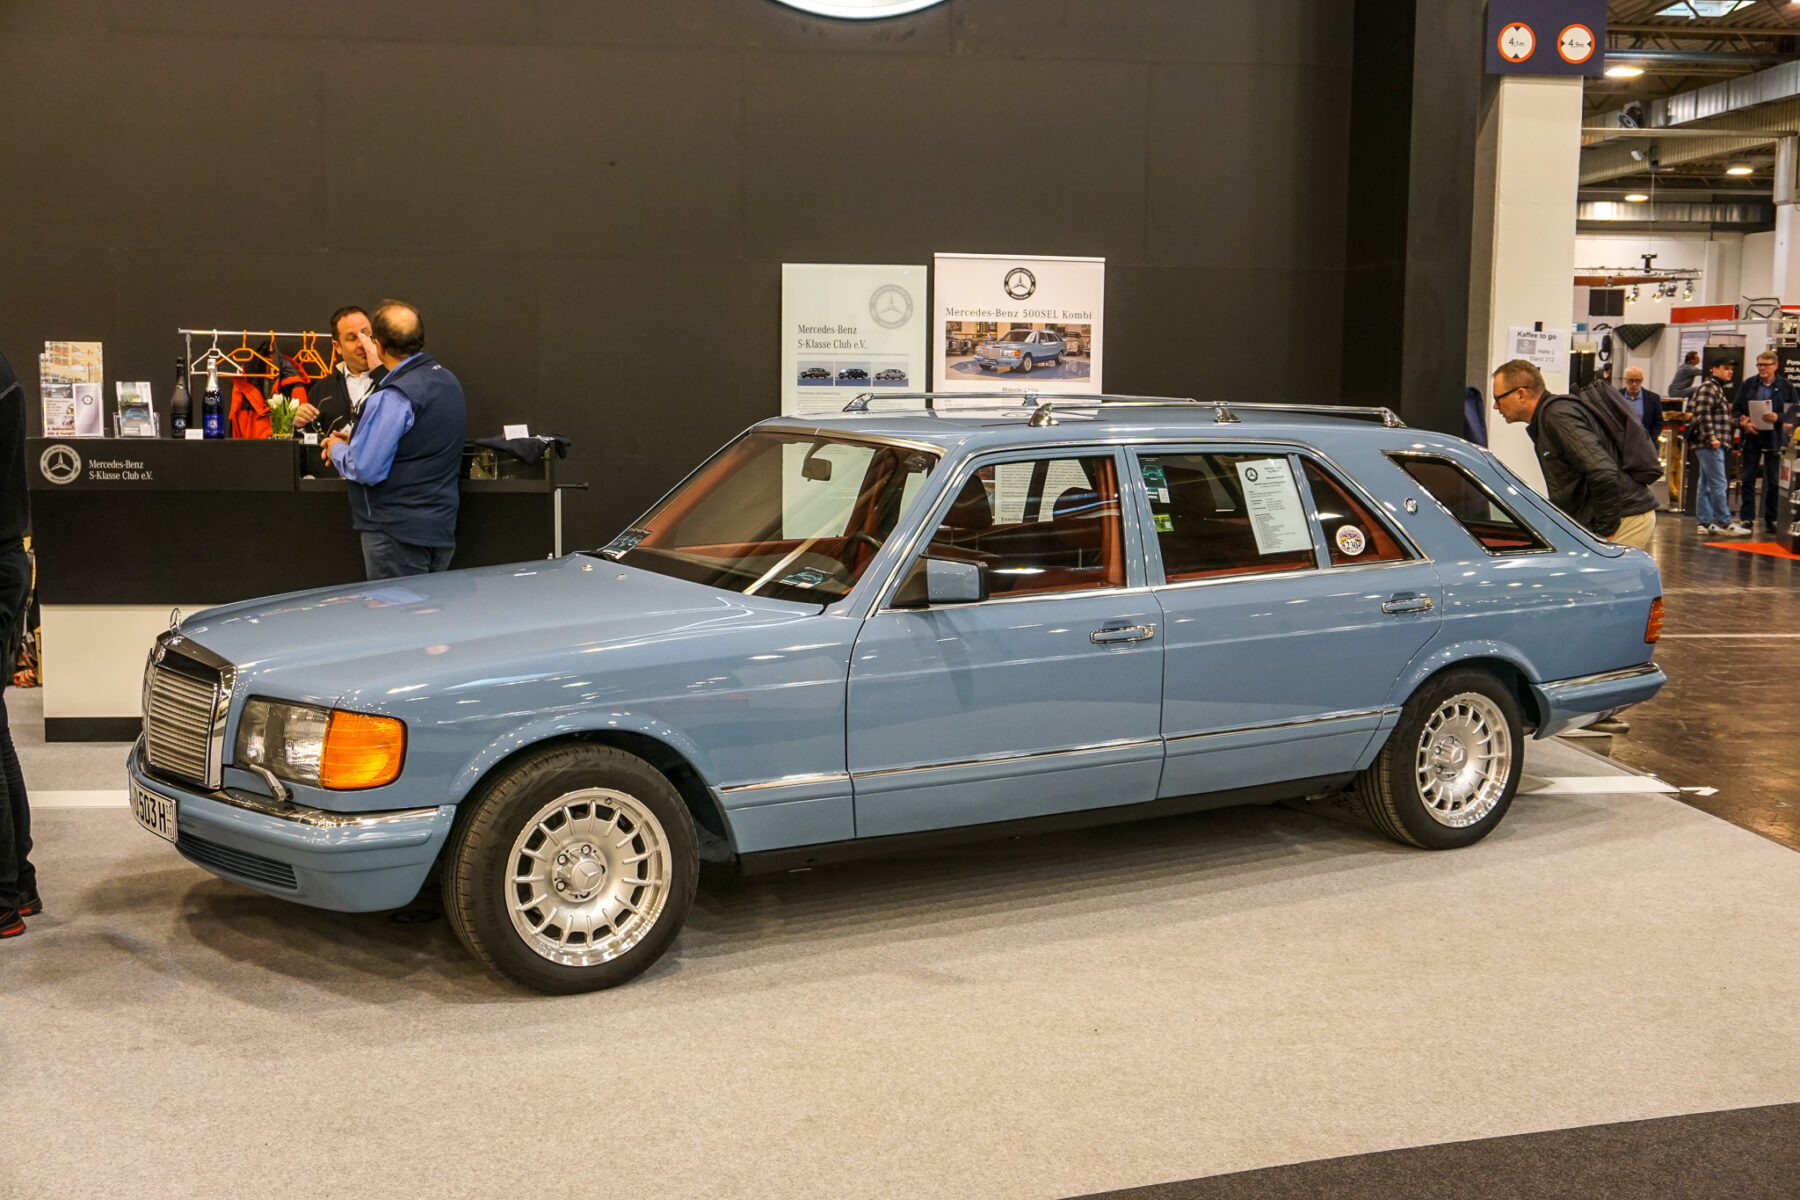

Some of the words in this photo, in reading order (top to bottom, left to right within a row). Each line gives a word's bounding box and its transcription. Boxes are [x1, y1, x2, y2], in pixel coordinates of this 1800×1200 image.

[945, 308, 1019, 318] Mercedes-Benz
[1023, 309, 1059, 319] 500SEL
[1062, 311, 1093, 320] Kombi
[797, 324, 857, 334] Mercedes-Benz
[797, 340, 832, 349] S-Klasse
[833, 340, 852, 349] Club
[853, 340, 867, 350] e.V.
[88, 459, 144, 470] Mercedes-Benz
[88, 470, 120, 480] S-Klasse
[122, 470, 140, 480] Club
[141, 471, 154, 480] e.V.
